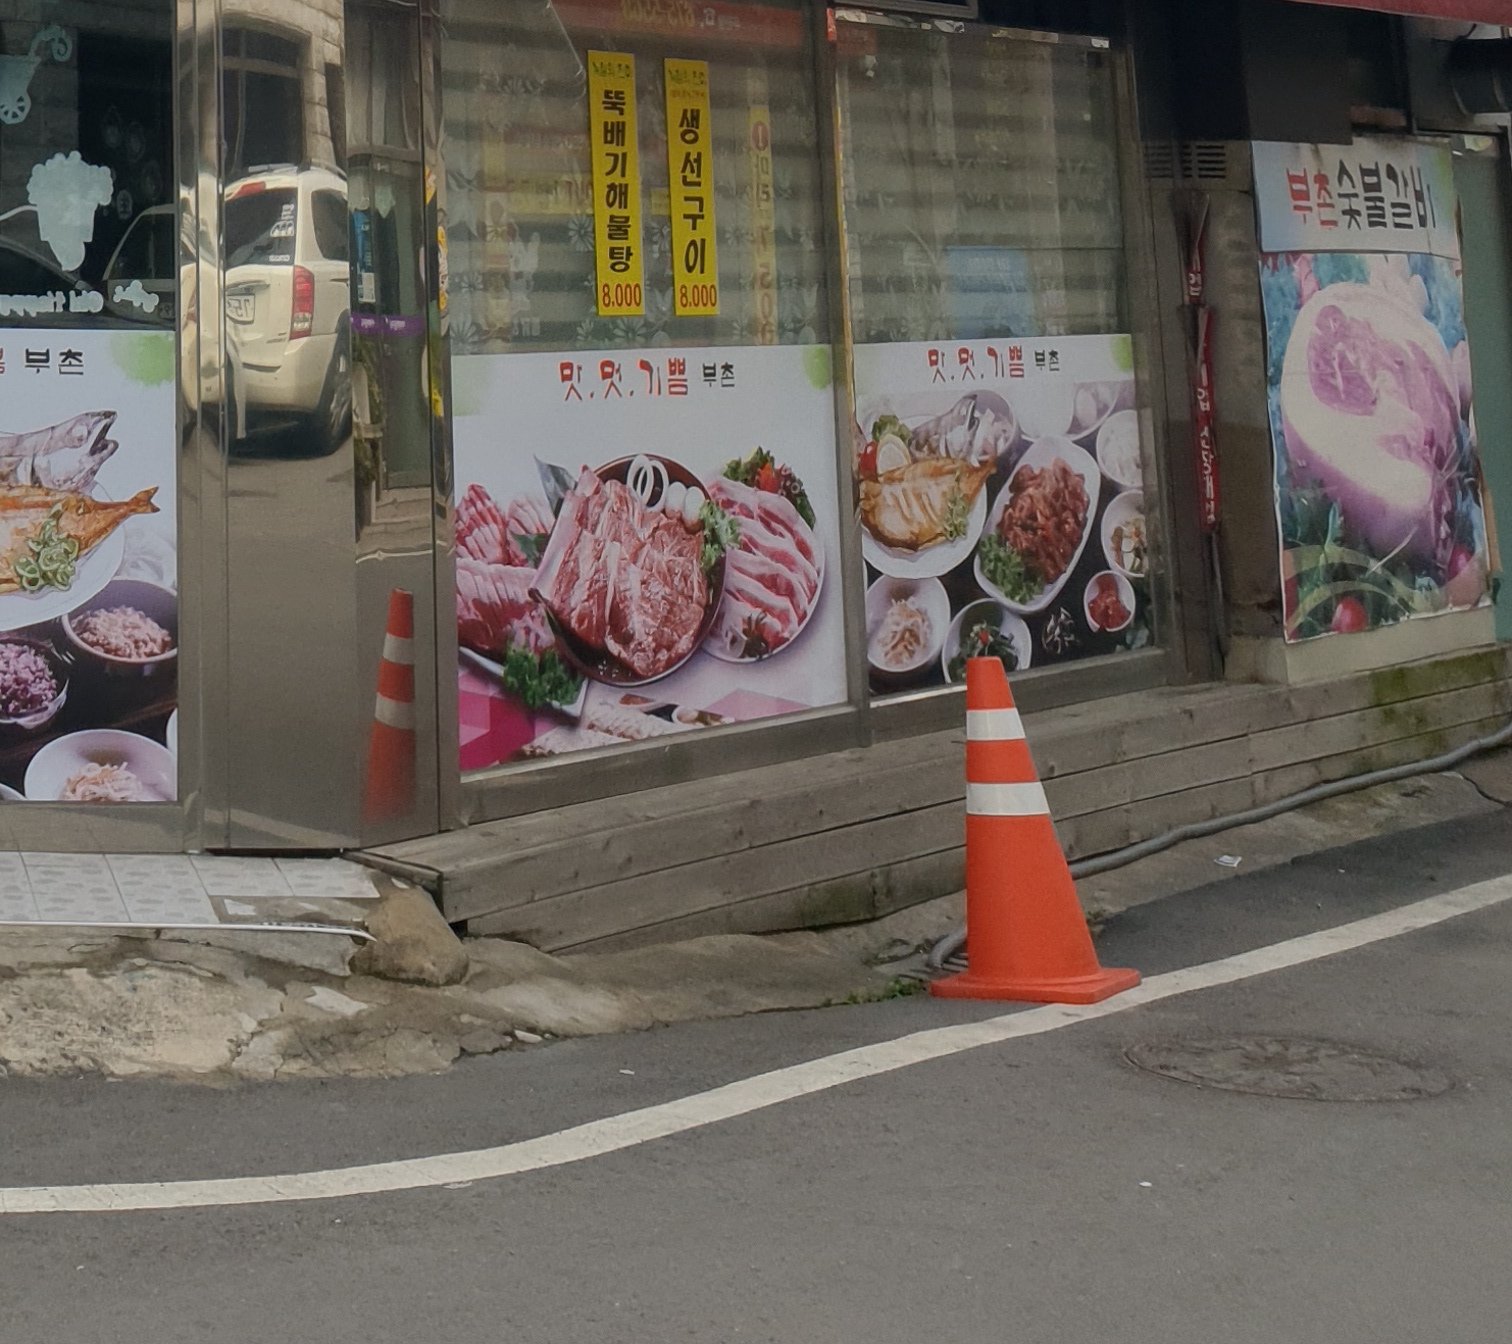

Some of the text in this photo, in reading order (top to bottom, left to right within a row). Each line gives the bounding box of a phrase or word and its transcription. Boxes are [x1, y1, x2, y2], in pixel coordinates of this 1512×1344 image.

[601, 89, 634, 272] 뚝배기해물탕
[678, 108, 707, 275] 생선구이
[1288, 160, 1437, 230] 부촌 숯불갈비
[602, 283, 642, 308] 8.000
[679, 284, 717, 309] 8.000
[25, 348, 85, 376] 부촌
[1034, 347, 1060, 373] 부촌
[702, 361, 736, 388] 부촌
